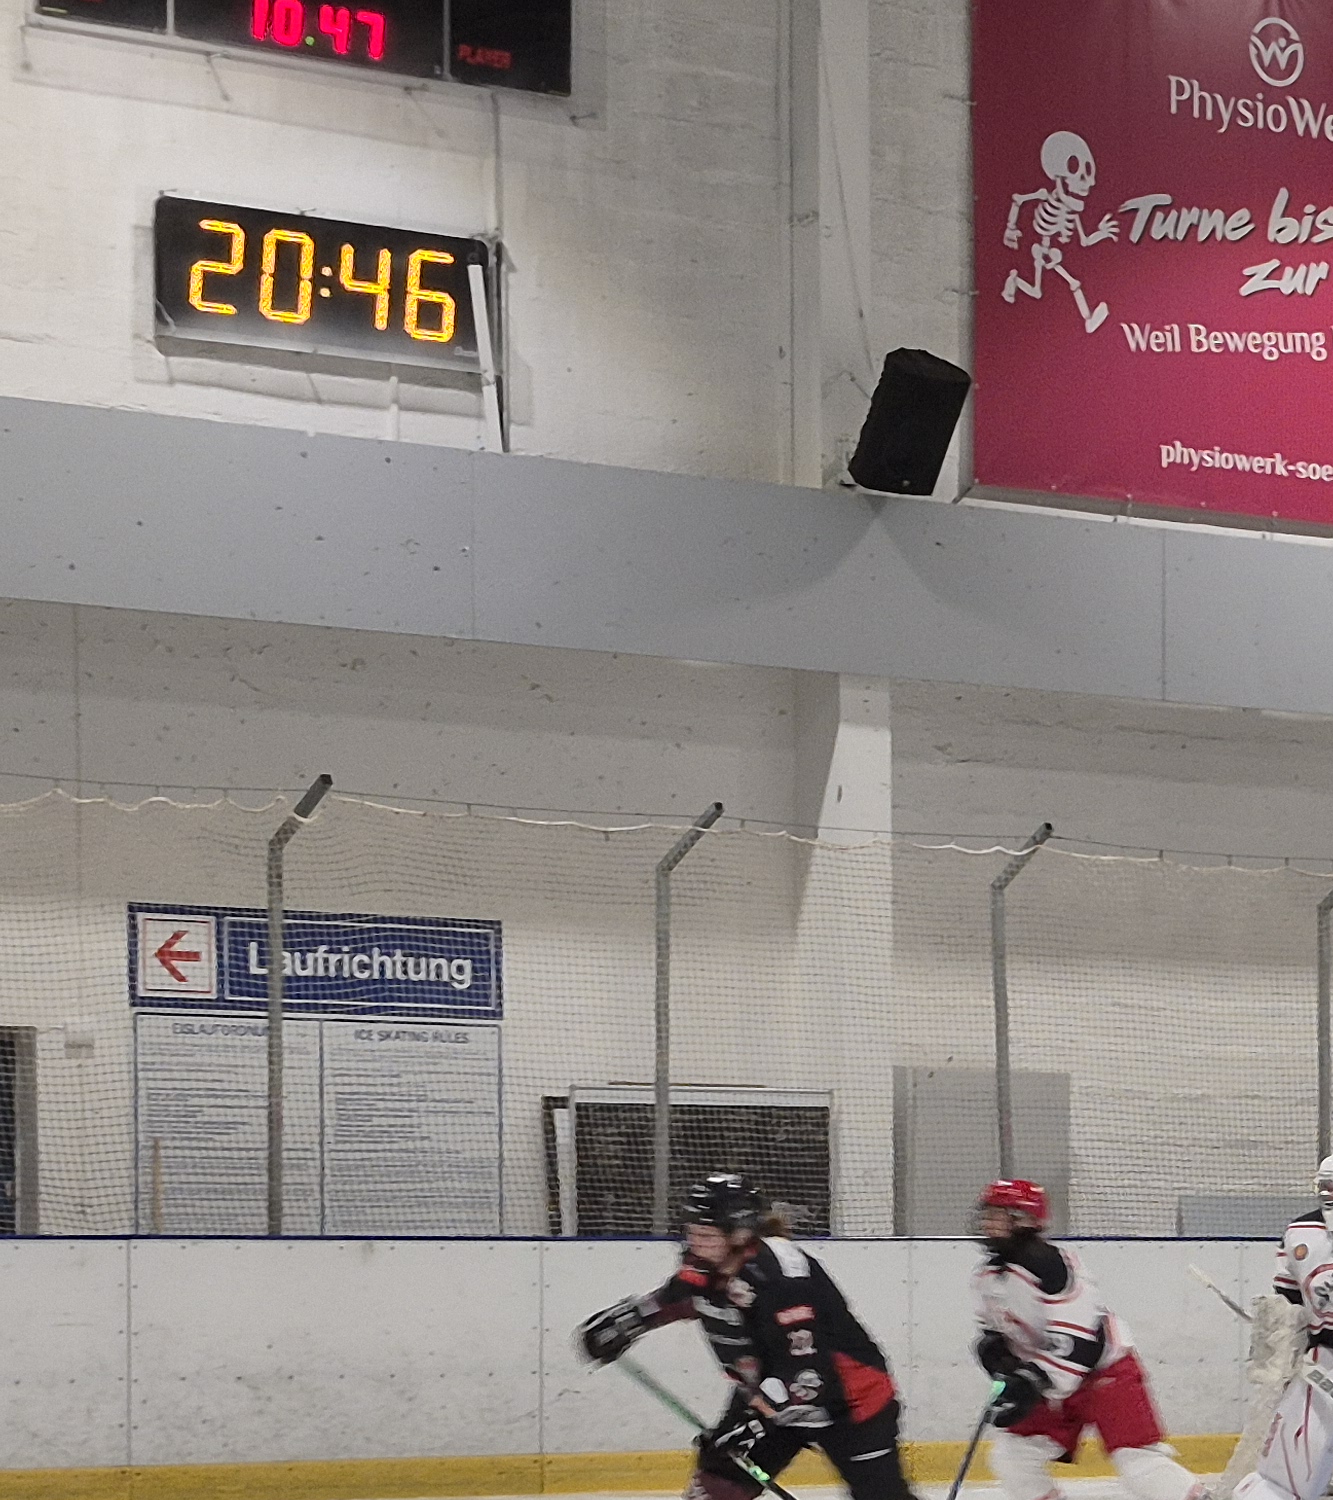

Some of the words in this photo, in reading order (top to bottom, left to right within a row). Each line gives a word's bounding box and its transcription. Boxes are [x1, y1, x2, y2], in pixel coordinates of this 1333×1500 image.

[1119, 193, 1256, 244] Turne
[188, 218, 456, 343] 20:46
[1239, 258, 1330, 297] zur
[1121, 323, 1181, 353] Weil
[1187, 323, 1328, 361] Bewegung
[249, 941, 472, 990] Laufrichtung
